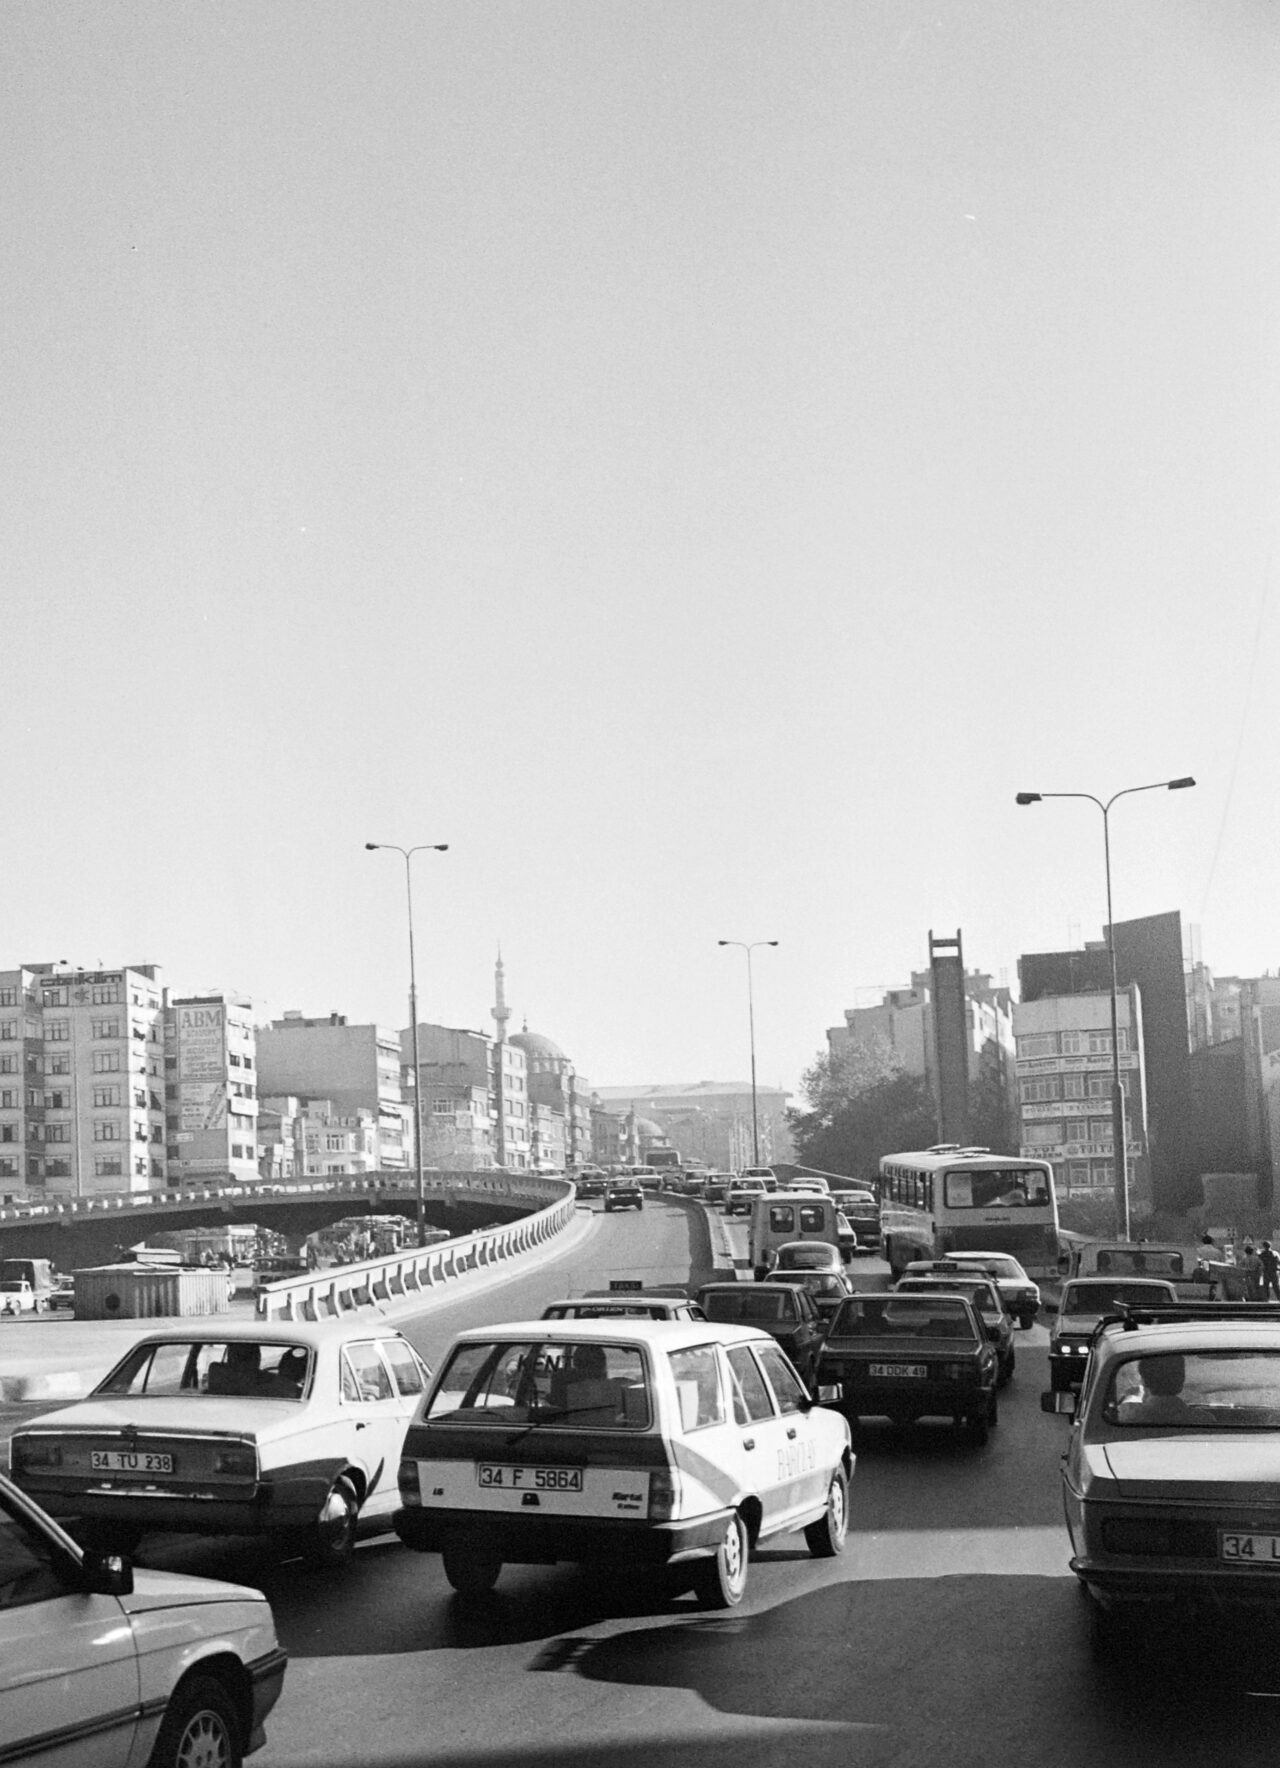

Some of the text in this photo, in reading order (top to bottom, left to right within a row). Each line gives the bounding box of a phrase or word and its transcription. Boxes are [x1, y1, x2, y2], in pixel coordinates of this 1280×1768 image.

[182, 1010, 221, 1028] ABM
[518, 1354, 574, 1371] KENT
[871, 1365, 884, 1375] 34
[93, 1452, 171, 1471] 34 TU 238
[482, 1467, 580, 1488] 34 F 5864
[1225, 1536, 1255, 1558] 34
